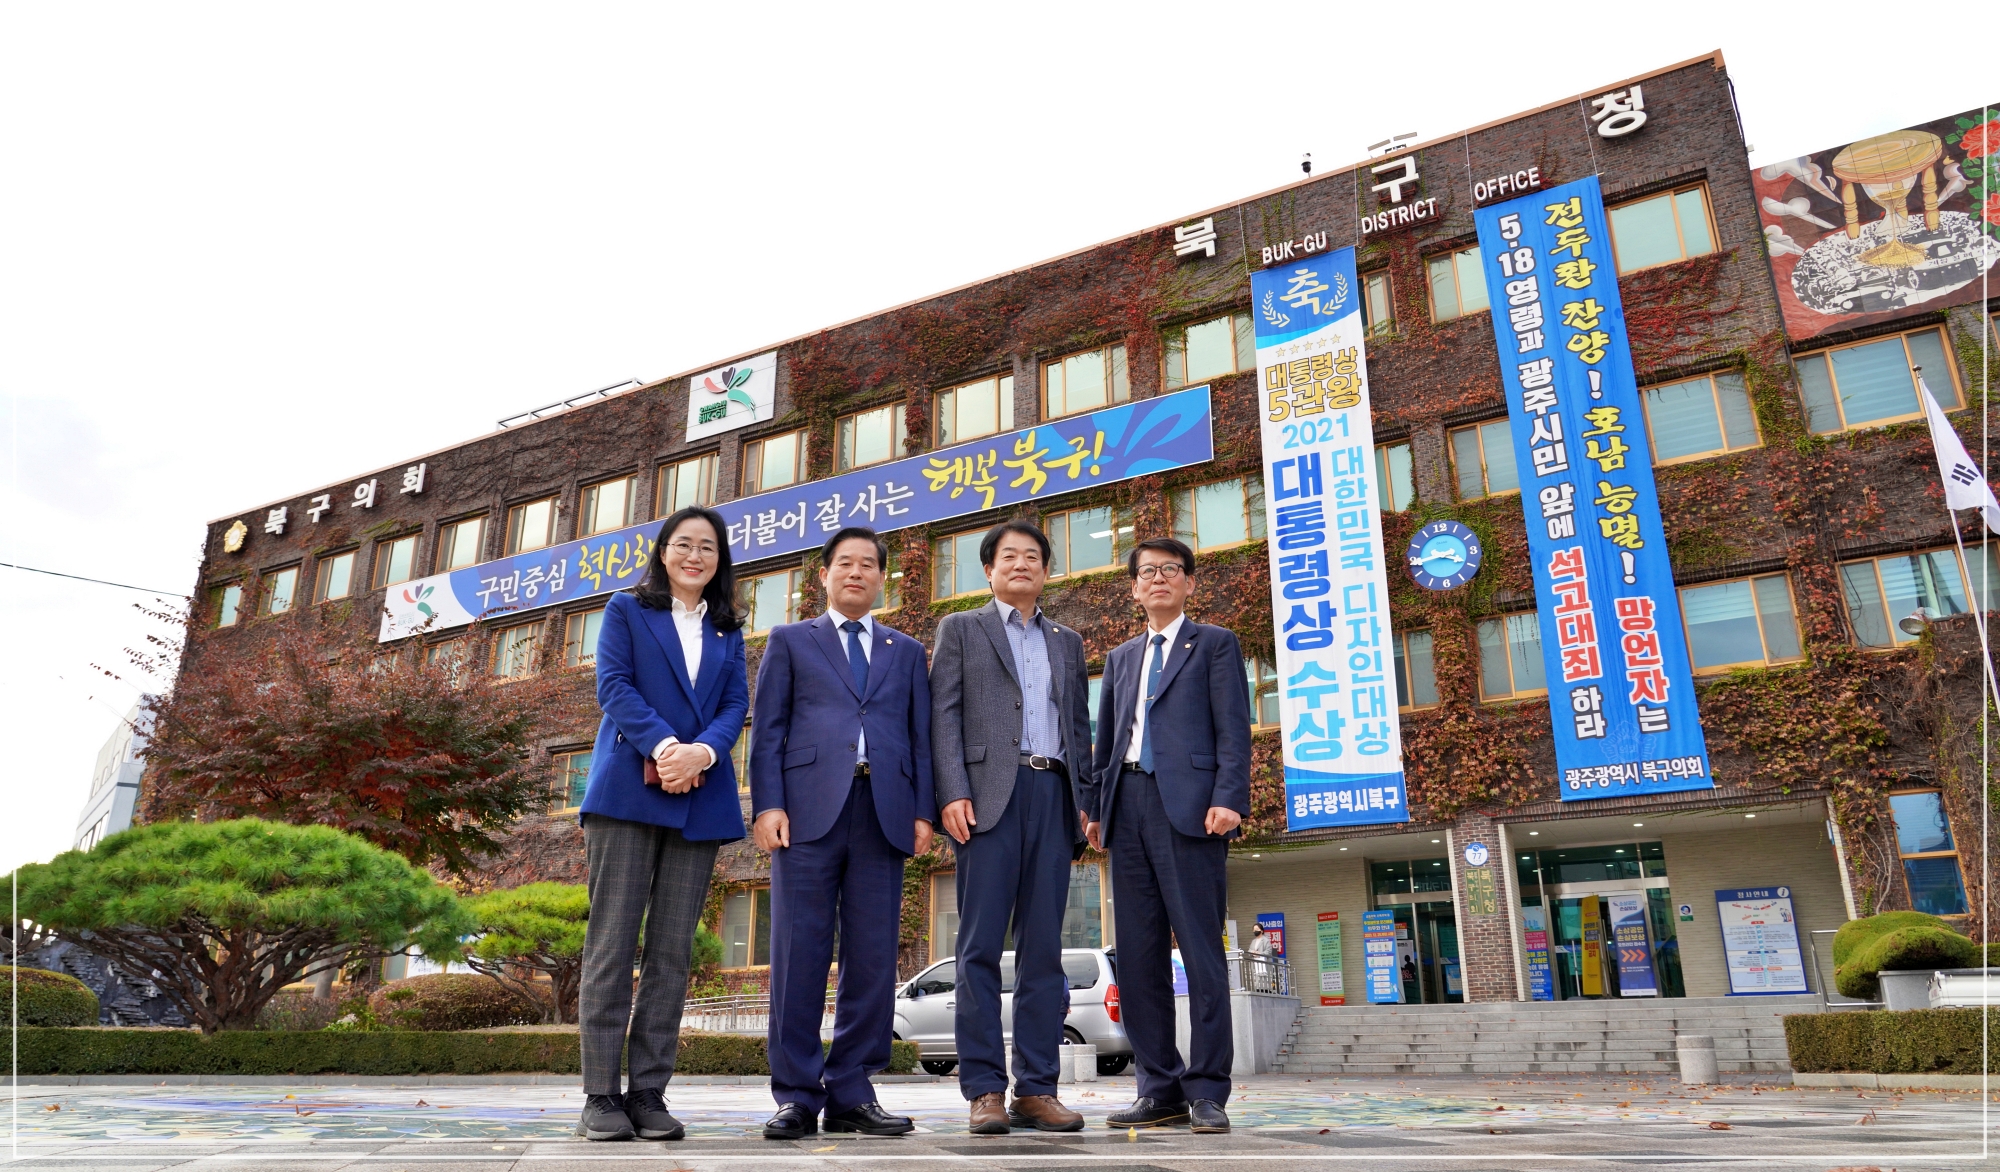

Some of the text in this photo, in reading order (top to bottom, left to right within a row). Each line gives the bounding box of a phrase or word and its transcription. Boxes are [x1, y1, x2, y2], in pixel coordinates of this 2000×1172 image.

[1590, 86, 1648, 139] 청
[1371, 155, 1420, 203] 구
[1473, 167, 1540, 201] OFFICE
[1360, 198, 1437, 234] DISTRICT
[1173, 217, 1218, 259] 북
[1262, 232, 1327, 265] BUK-GU
[1544, 197, 1597, 289] 전두환
[1280, 268, 1328, 315] 축
[1265, 347, 1358, 391] 대통령상
[699, 408, 727, 424] BUK-GU
[1268, 372, 1362, 422] 5관왕
[1282, 413, 1350, 449] 2021
[475, 559, 567, 609] 구민중심
[727, 502, 806, 550] 더불어
[814, 493, 845, 531] 잘
[848, 482, 914, 523] 사는
[921, 449, 999, 510] 행복
[1002, 430, 1105, 495] 북구!
[1433, 523, 1447, 533] 12
[1539, 482, 1576, 541] 앞에
[1469, 546, 1478, 555] 3
[1332, 446, 1391, 756] 대한민국 디자인대상
[1443, 579, 1451, 588] 6
[1272, 452, 1346, 762] 대통령상 수상
[1565, 755, 1704, 790] 광주광역시 북구의회
[1480, 870, 1495, 912] 북구청
